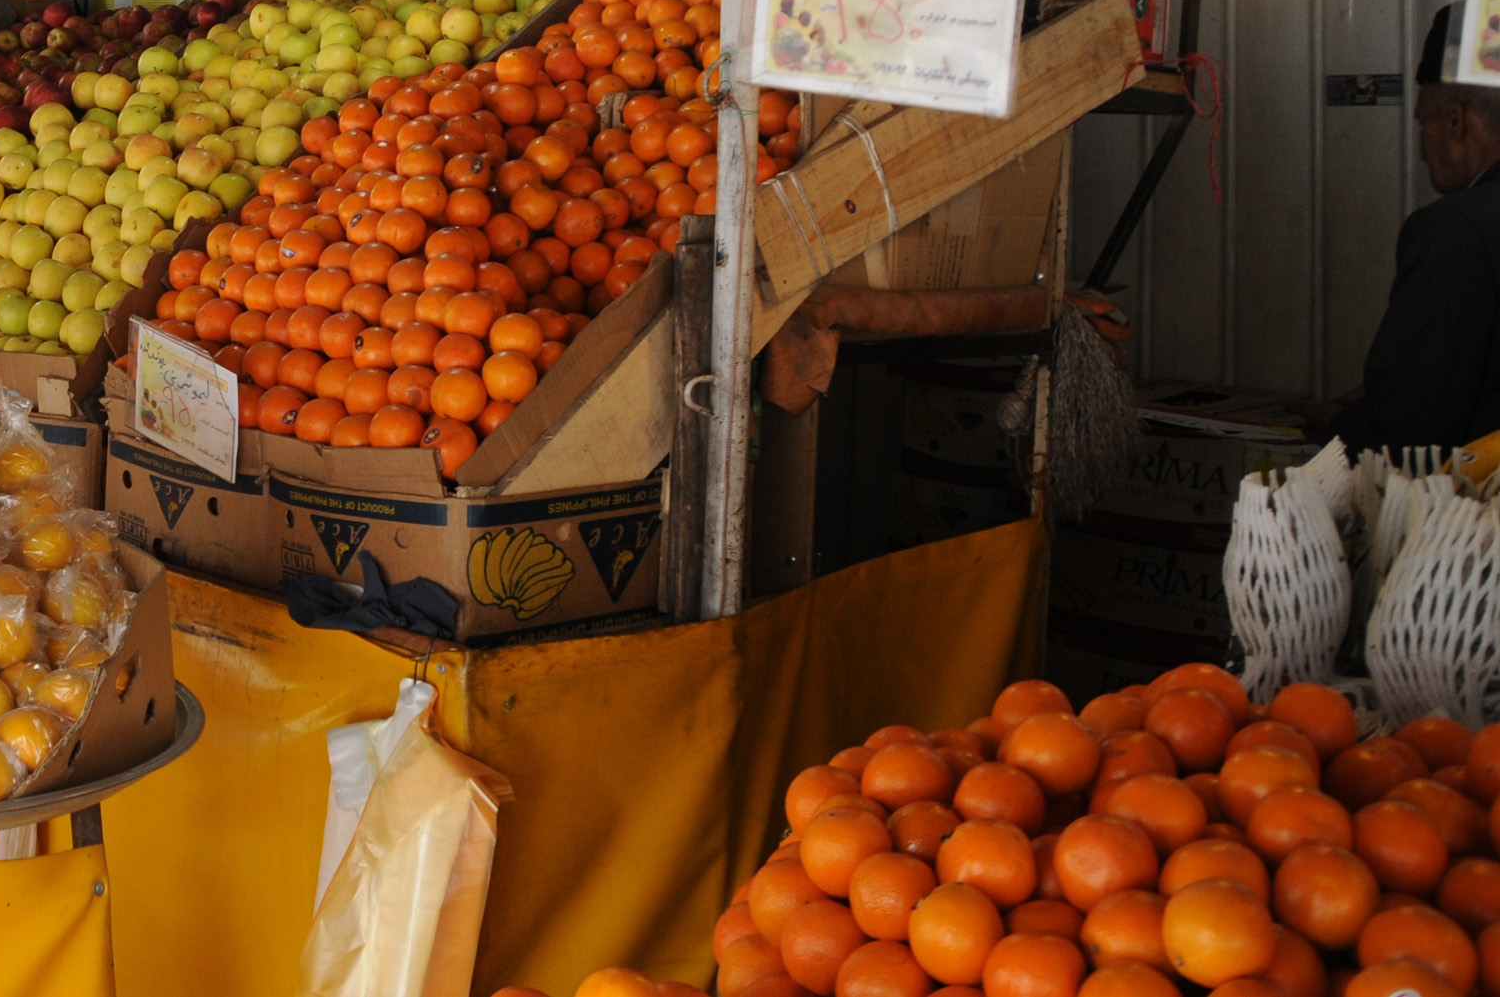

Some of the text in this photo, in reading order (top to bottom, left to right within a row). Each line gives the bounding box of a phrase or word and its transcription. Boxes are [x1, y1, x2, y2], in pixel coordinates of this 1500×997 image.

[1129, 453, 1231, 496] RIMA
[154, 480, 192, 505] Ace
[288, 490, 396, 515] PRODUCT OF THE PHILIPPINES
[547, 495, 611, 514] PHILIPPINES
[612, 492, 632, 504] THE
[633, 490, 646, 503] OF
[317, 520, 366, 545] Ace
[588, 515, 660, 549] Ace
